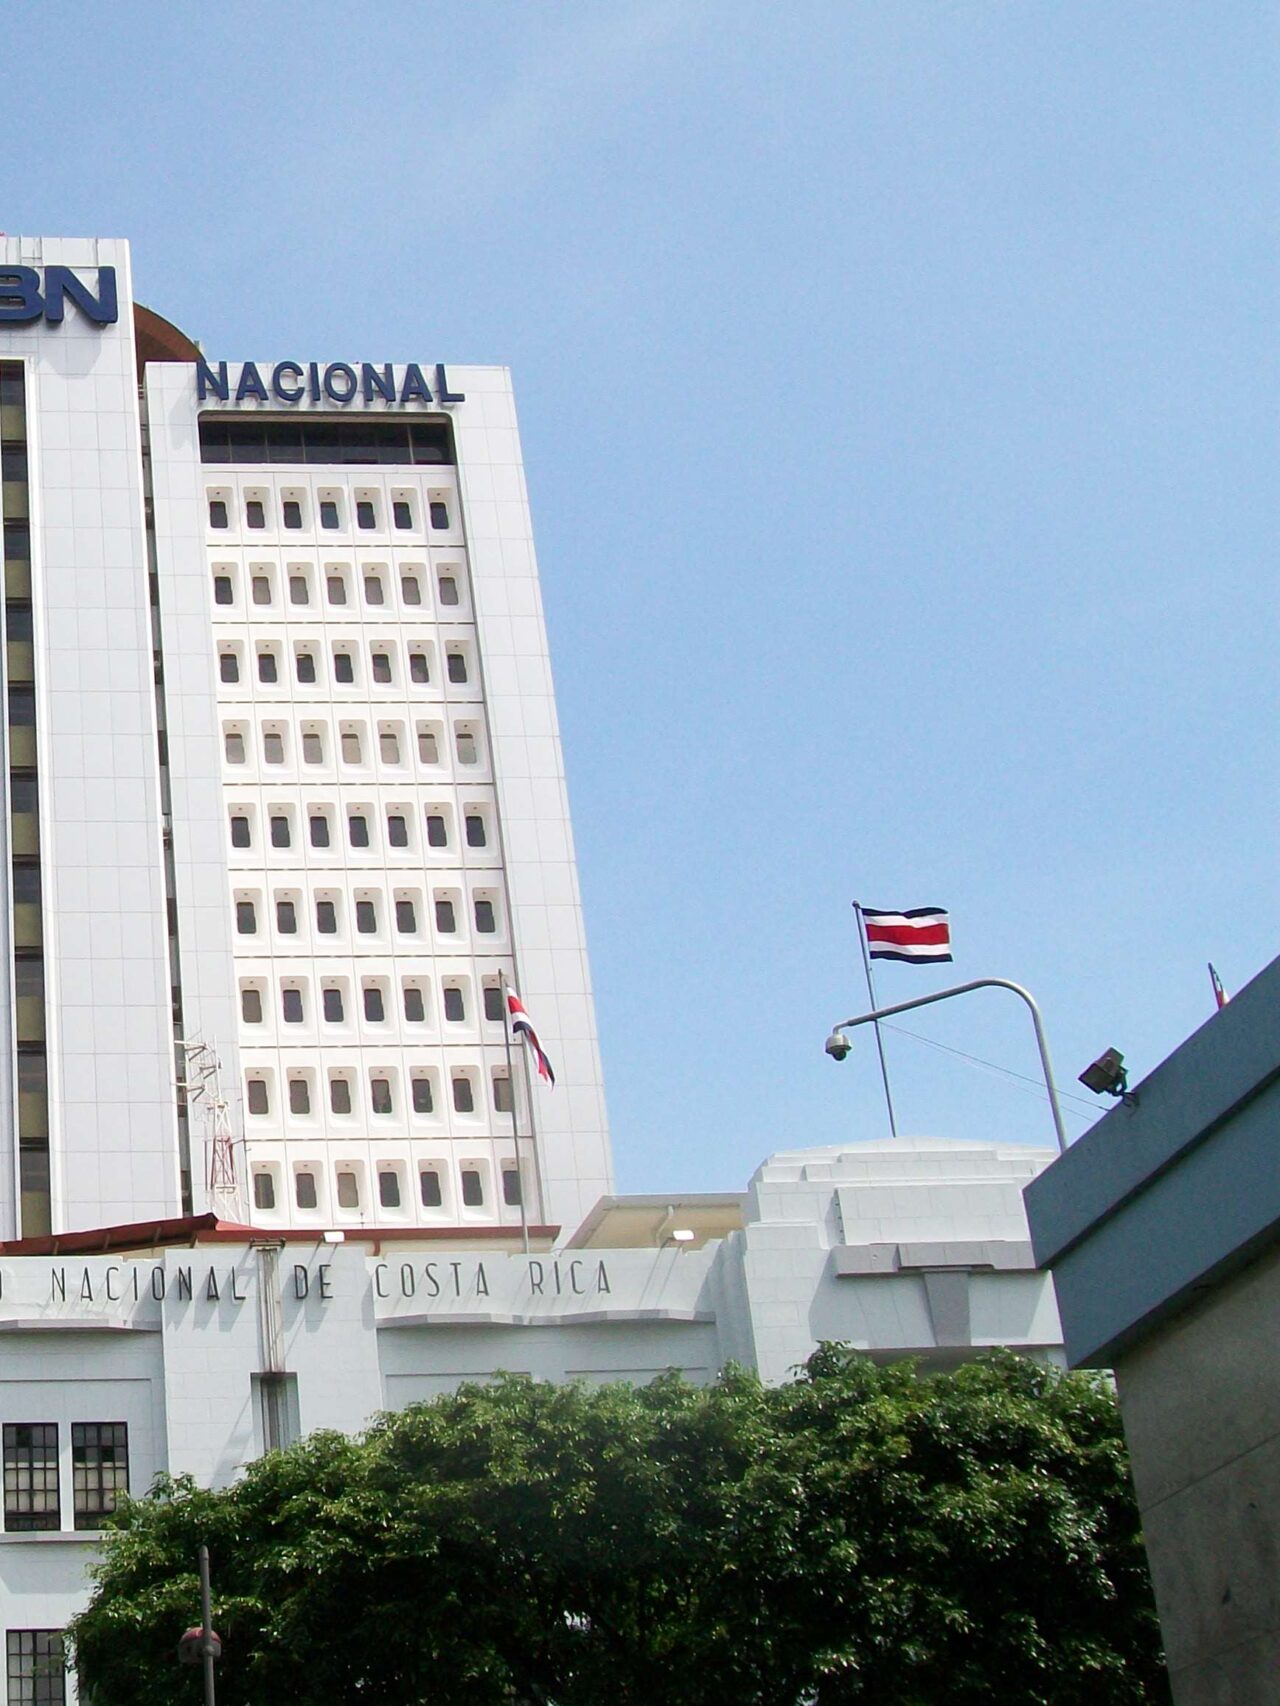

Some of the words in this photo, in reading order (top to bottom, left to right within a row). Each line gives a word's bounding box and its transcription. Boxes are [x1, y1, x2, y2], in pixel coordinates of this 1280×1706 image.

[196, 360, 466, 403] NACIONAL
[51, 1265, 247, 1302] NACIONAL
[293, 1263, 332, 1300] DE
[374, 1261, 490, 1298] COSTA
[528, 1259, 611, 1295] RICA
